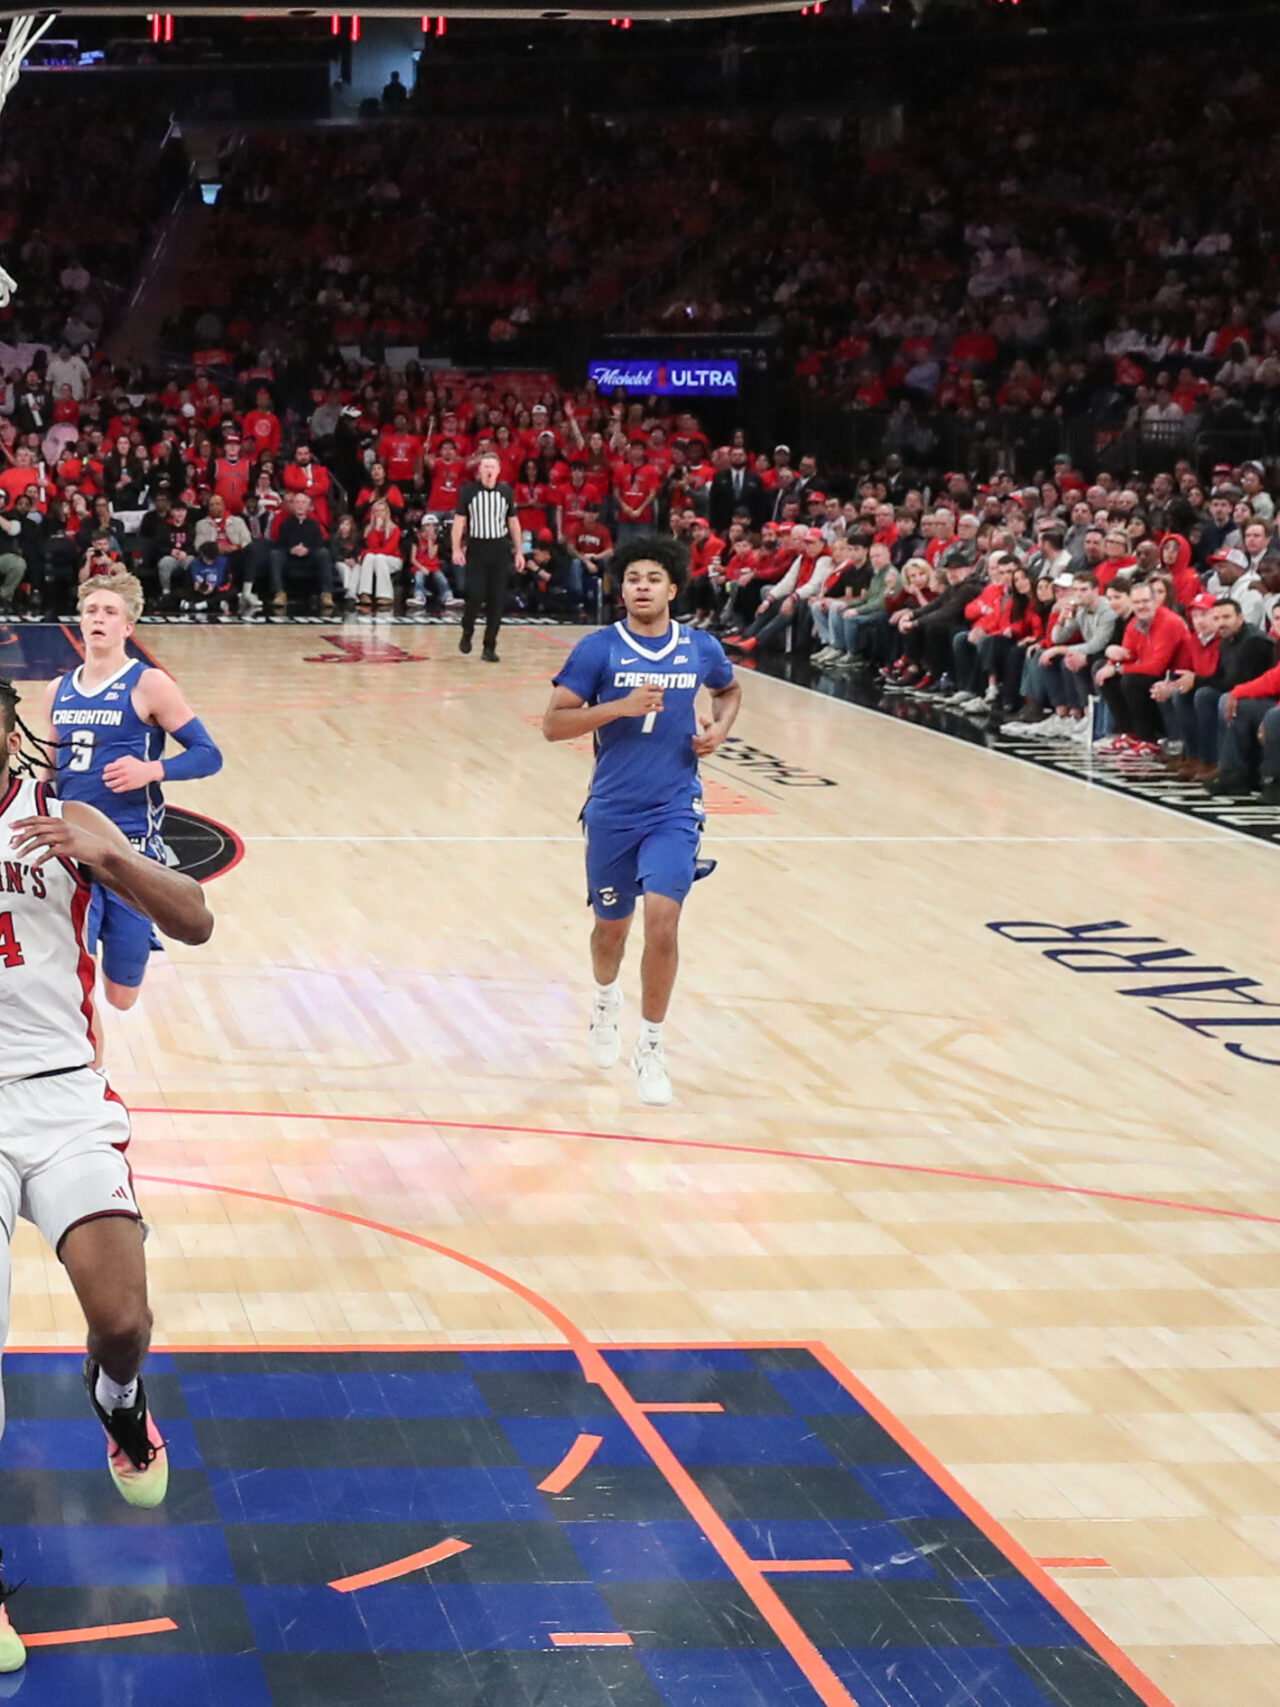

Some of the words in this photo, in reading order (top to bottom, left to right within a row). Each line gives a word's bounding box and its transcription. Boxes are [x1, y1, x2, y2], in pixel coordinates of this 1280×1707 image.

[592, 368, 653, 386] Michelob
[671, 370, 736, 387] ULTRA
[52, 709, 123, 726] CREIGHTON
